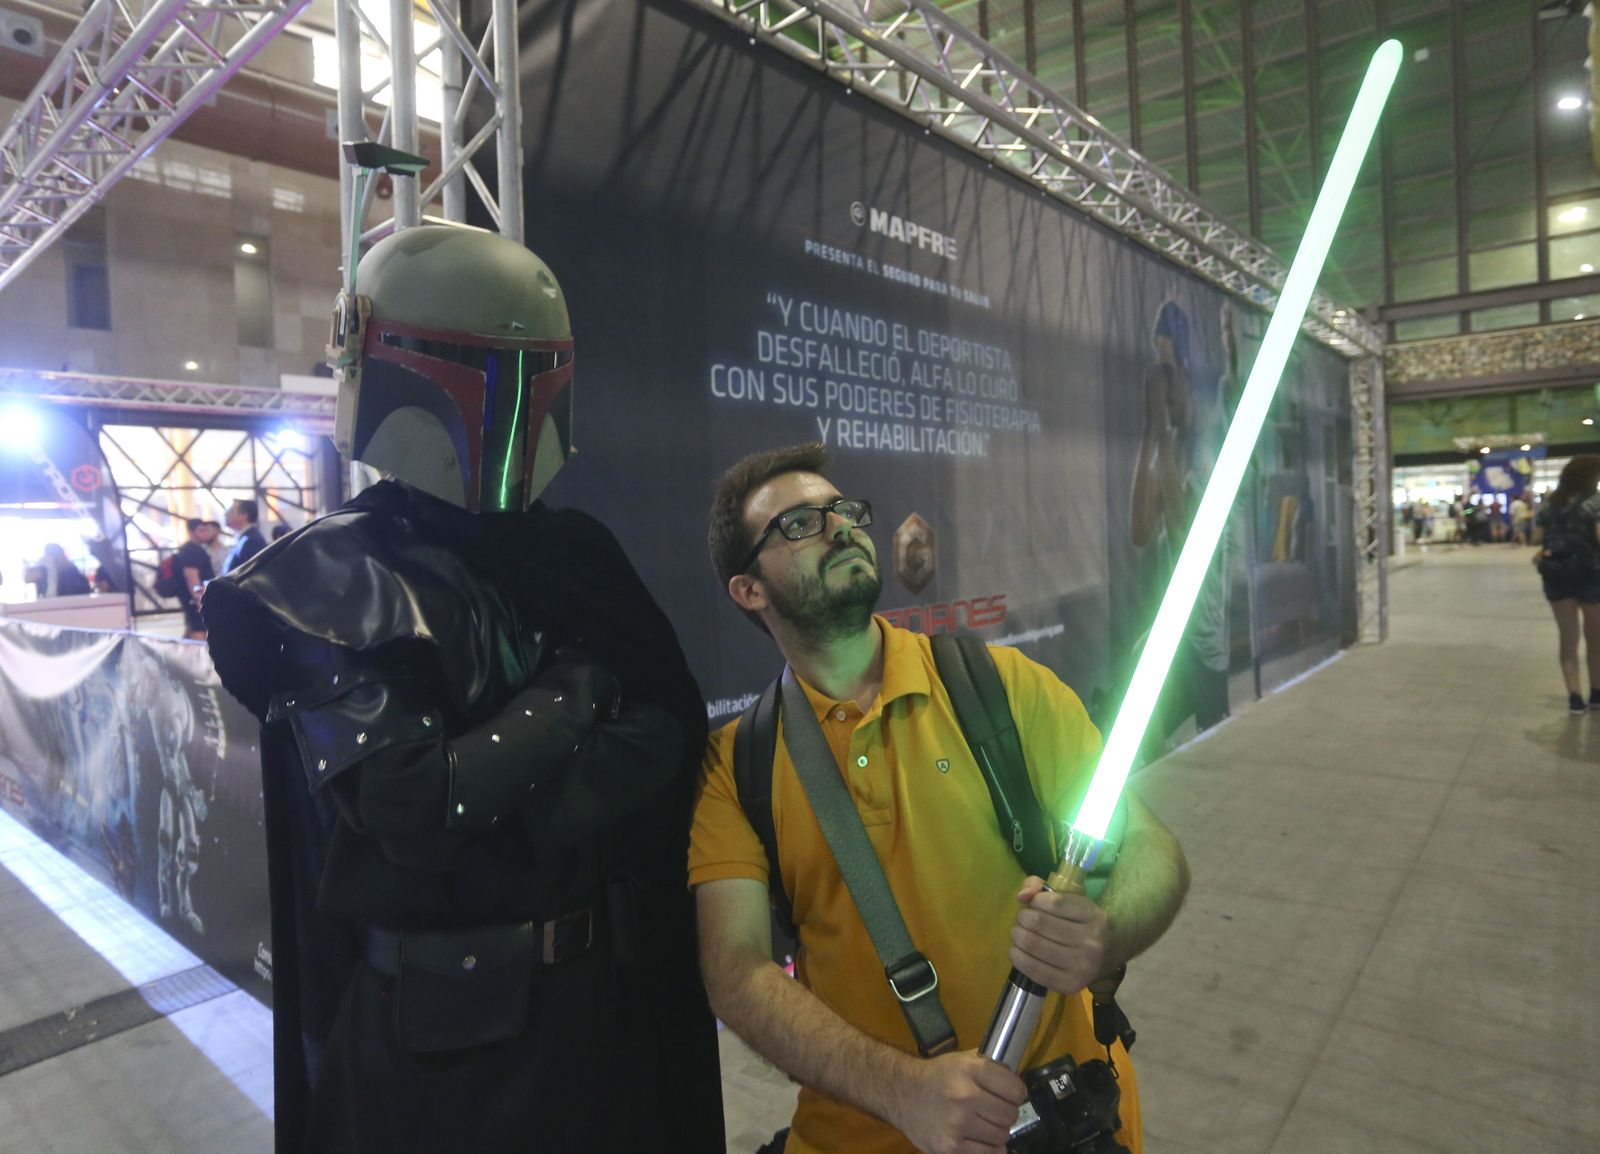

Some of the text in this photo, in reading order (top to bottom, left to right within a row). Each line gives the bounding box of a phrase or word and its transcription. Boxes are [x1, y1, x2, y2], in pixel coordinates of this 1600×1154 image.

[804, 239, 864, 268] PRESENTA
[867, 258, 880, 275] EL
[869, 207, 958, 261] MAPFRE
[758, 330, 1018, 402] DESFALLECIÓ, ALFA LO CURÓ
[799, 301, 887, 347] CUANDO
[893, 323, 913, 352] EL
[918, 329, 1012, 372] DEPORTISTA
[710, 363, 1041, 433] CON SUS PODERES DE FISIOTERAPIA
[816, 415, 831, 445] Y
